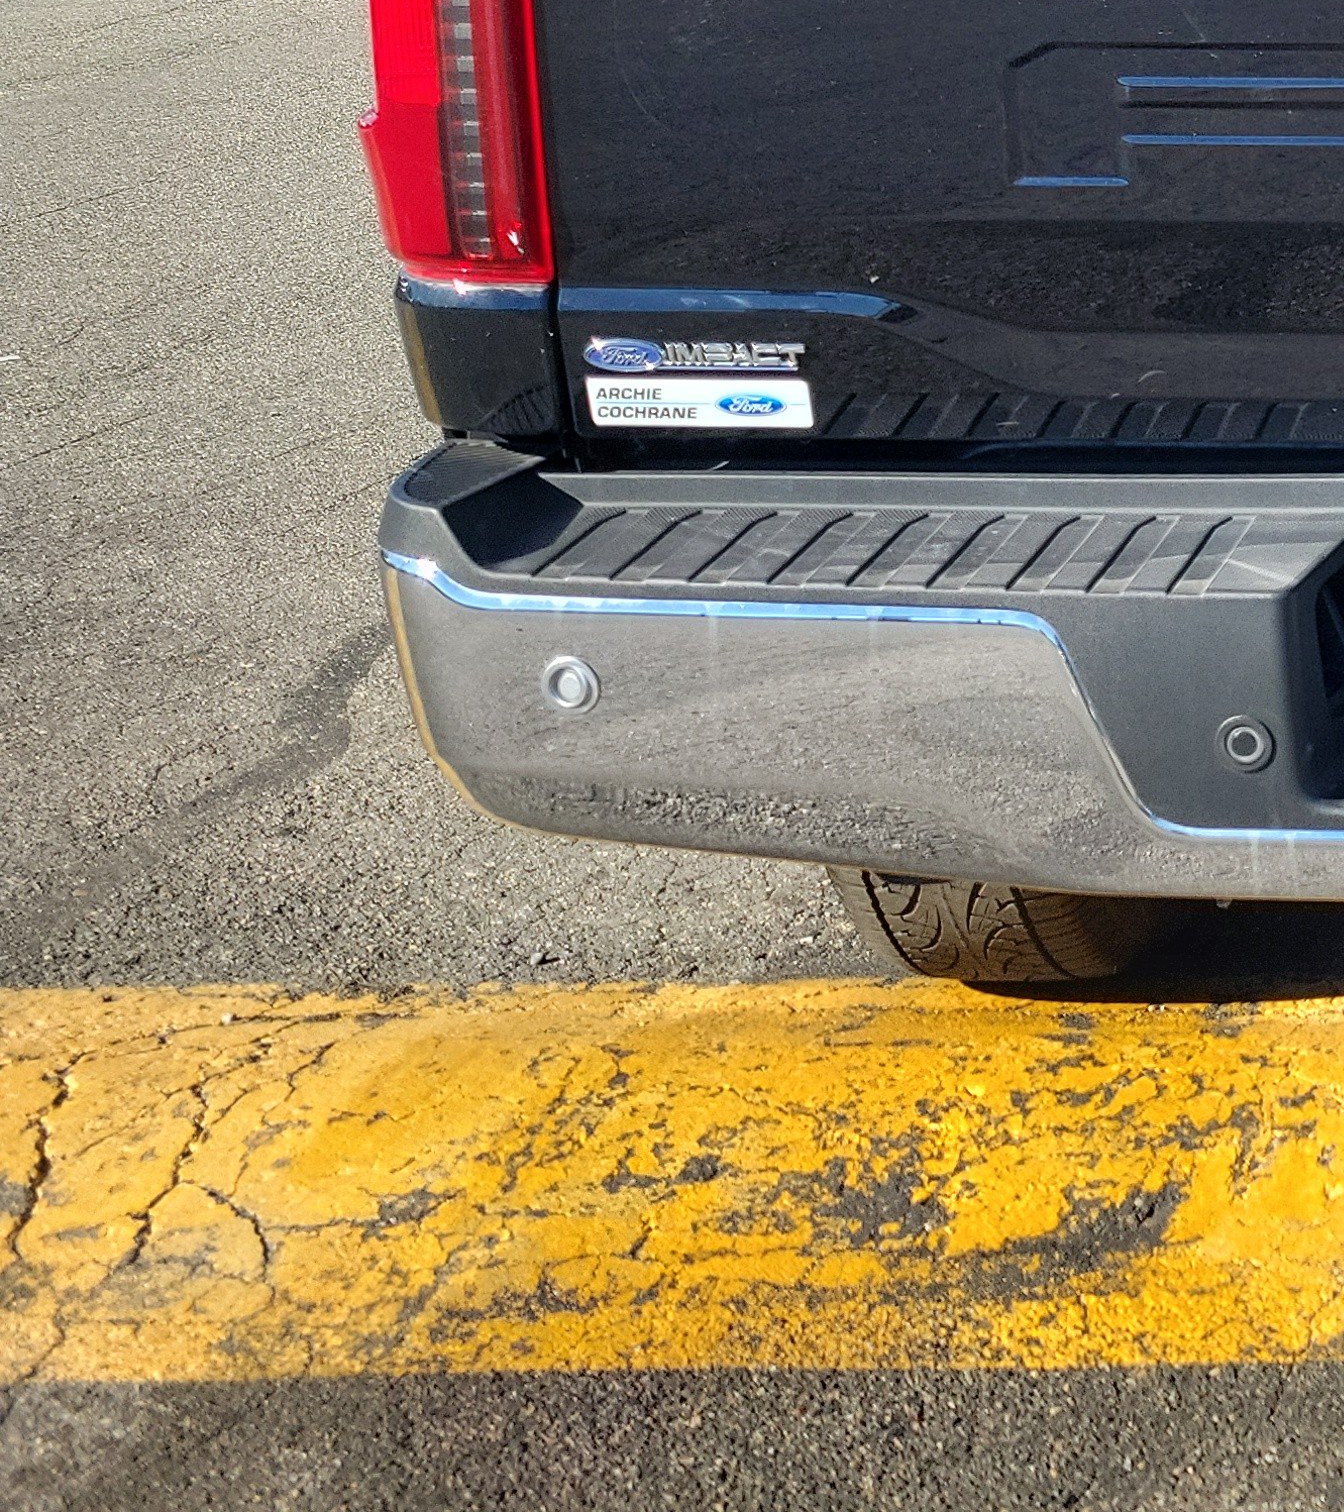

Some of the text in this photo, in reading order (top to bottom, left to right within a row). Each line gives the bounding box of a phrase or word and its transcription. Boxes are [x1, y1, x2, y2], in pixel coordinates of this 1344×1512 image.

[602, 346, 649, 365] Ford
[596, 386, 663, 401] ARCHIE
[597, 405, 698, 420] COCHRANE
[728, 395, 774, 414] Ford
